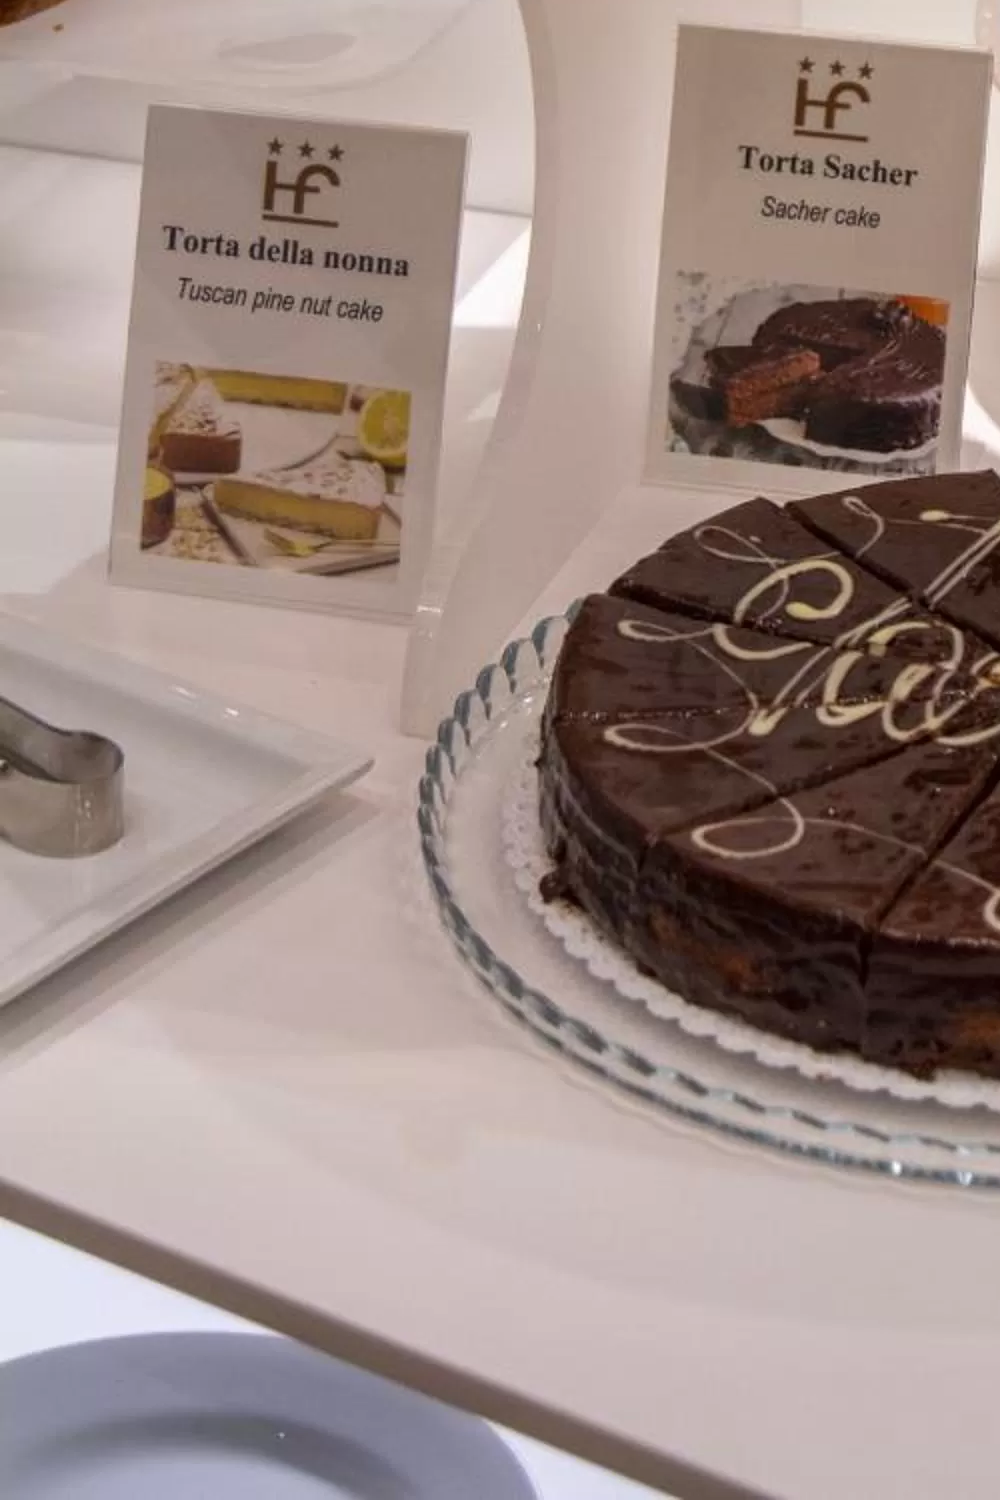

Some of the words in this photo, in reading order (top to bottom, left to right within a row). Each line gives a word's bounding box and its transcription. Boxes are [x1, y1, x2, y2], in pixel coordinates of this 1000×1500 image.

[737, 145, 815, 176] Torta
[823, 154, 919, 187] Sacher
[761, 196, 829, 223] Sacher
[834, 205, 881, 229] cake
[162, 225, 240, 257] Torta
[248, 236, 314, 266] della
[323, 249, 410, 277] nonna
[177, 277, 248, 305] Tuscan
[252, 288, 295, 313] pine
[299, 297, 331, 316] nut
[336, 299, 384, 323] cake
